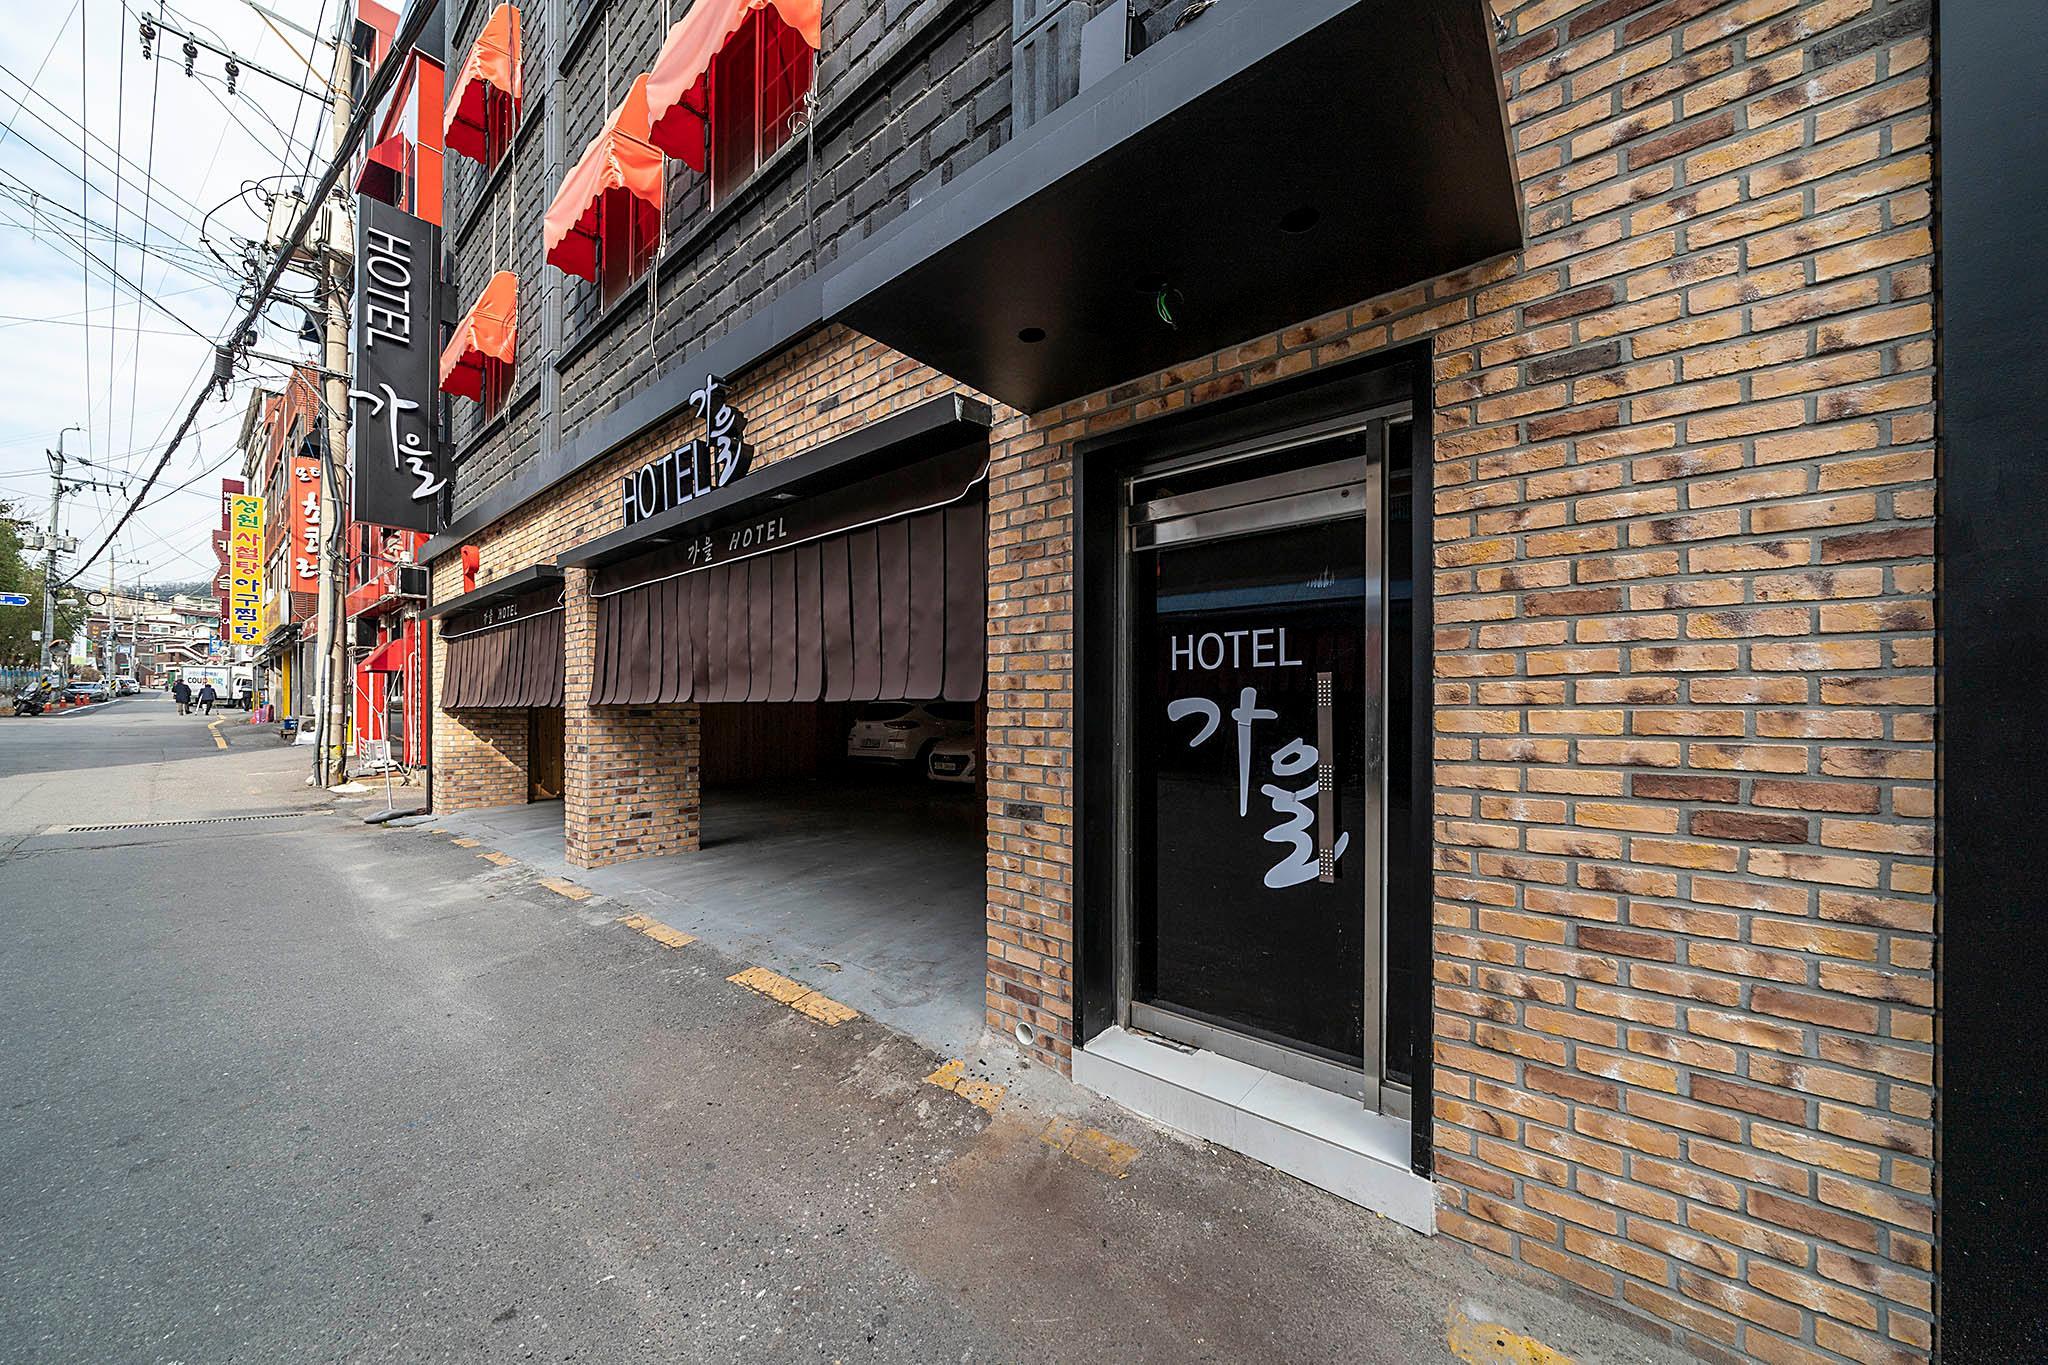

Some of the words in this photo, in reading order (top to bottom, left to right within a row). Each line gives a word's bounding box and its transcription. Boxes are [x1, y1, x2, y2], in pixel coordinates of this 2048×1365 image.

[367, 226, 411, 347] HOTEL
[349, 383, 448, 500] 가을
[622, 439, 711, 528] HOTEL
[689, 374, 742, 487] 가을
[688, 536, 713, 565] 가을
[729, 517, 787, 551] HOTEL
[498, 604, 518, 620] HOTEL
[1171, 627, 1303, 671] HOTEL
[187, 677, 224, 686] coupang
[1167, 686, 1349, 889] 가을
